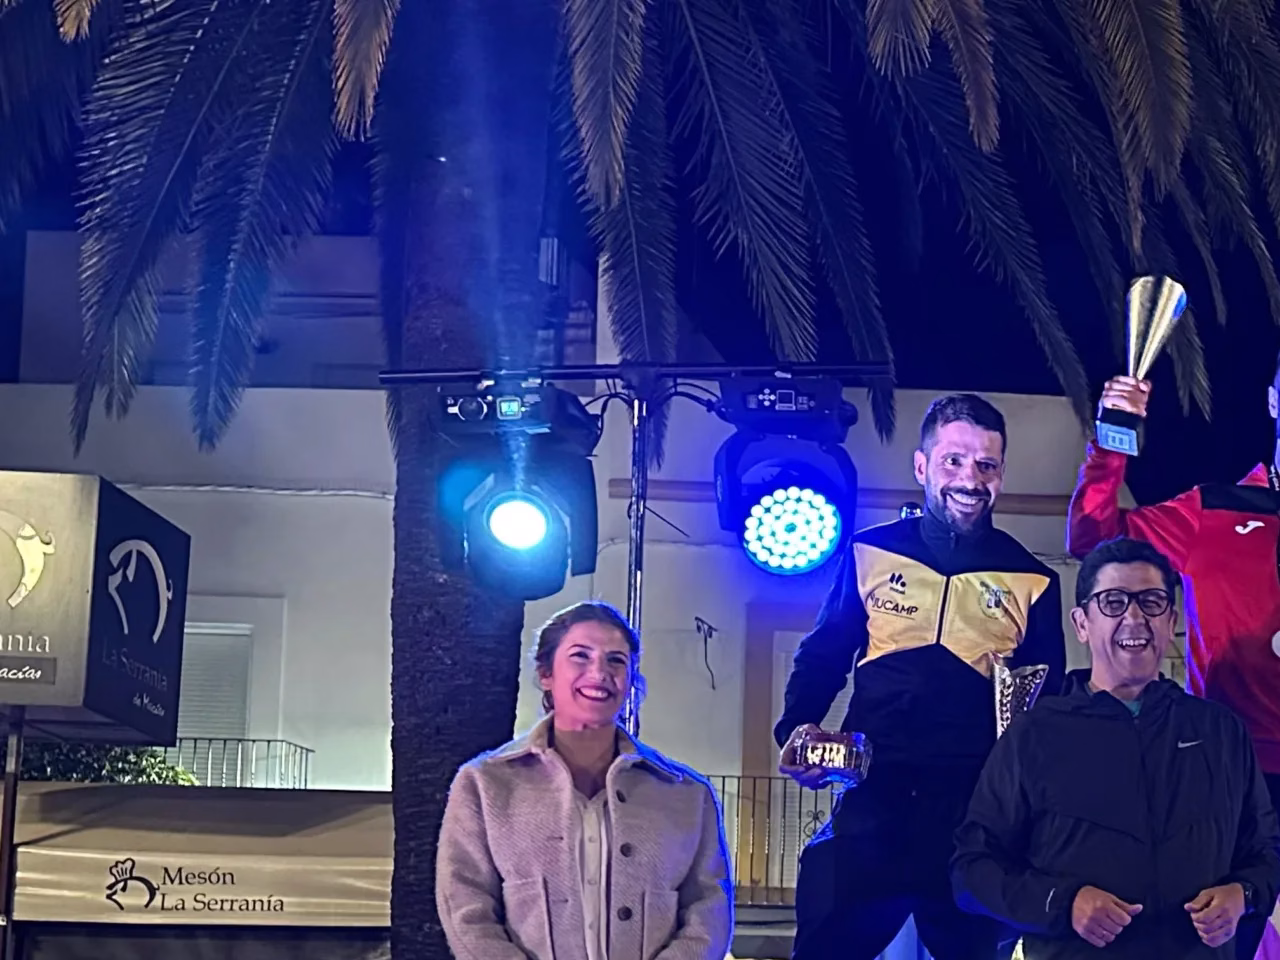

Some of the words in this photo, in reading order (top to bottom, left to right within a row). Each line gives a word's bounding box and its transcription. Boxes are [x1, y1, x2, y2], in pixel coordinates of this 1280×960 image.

[161, 866, 236, 885] Mesón
[160, 893, 186, 911] La
[193, 893, 284, 912] Serranía
